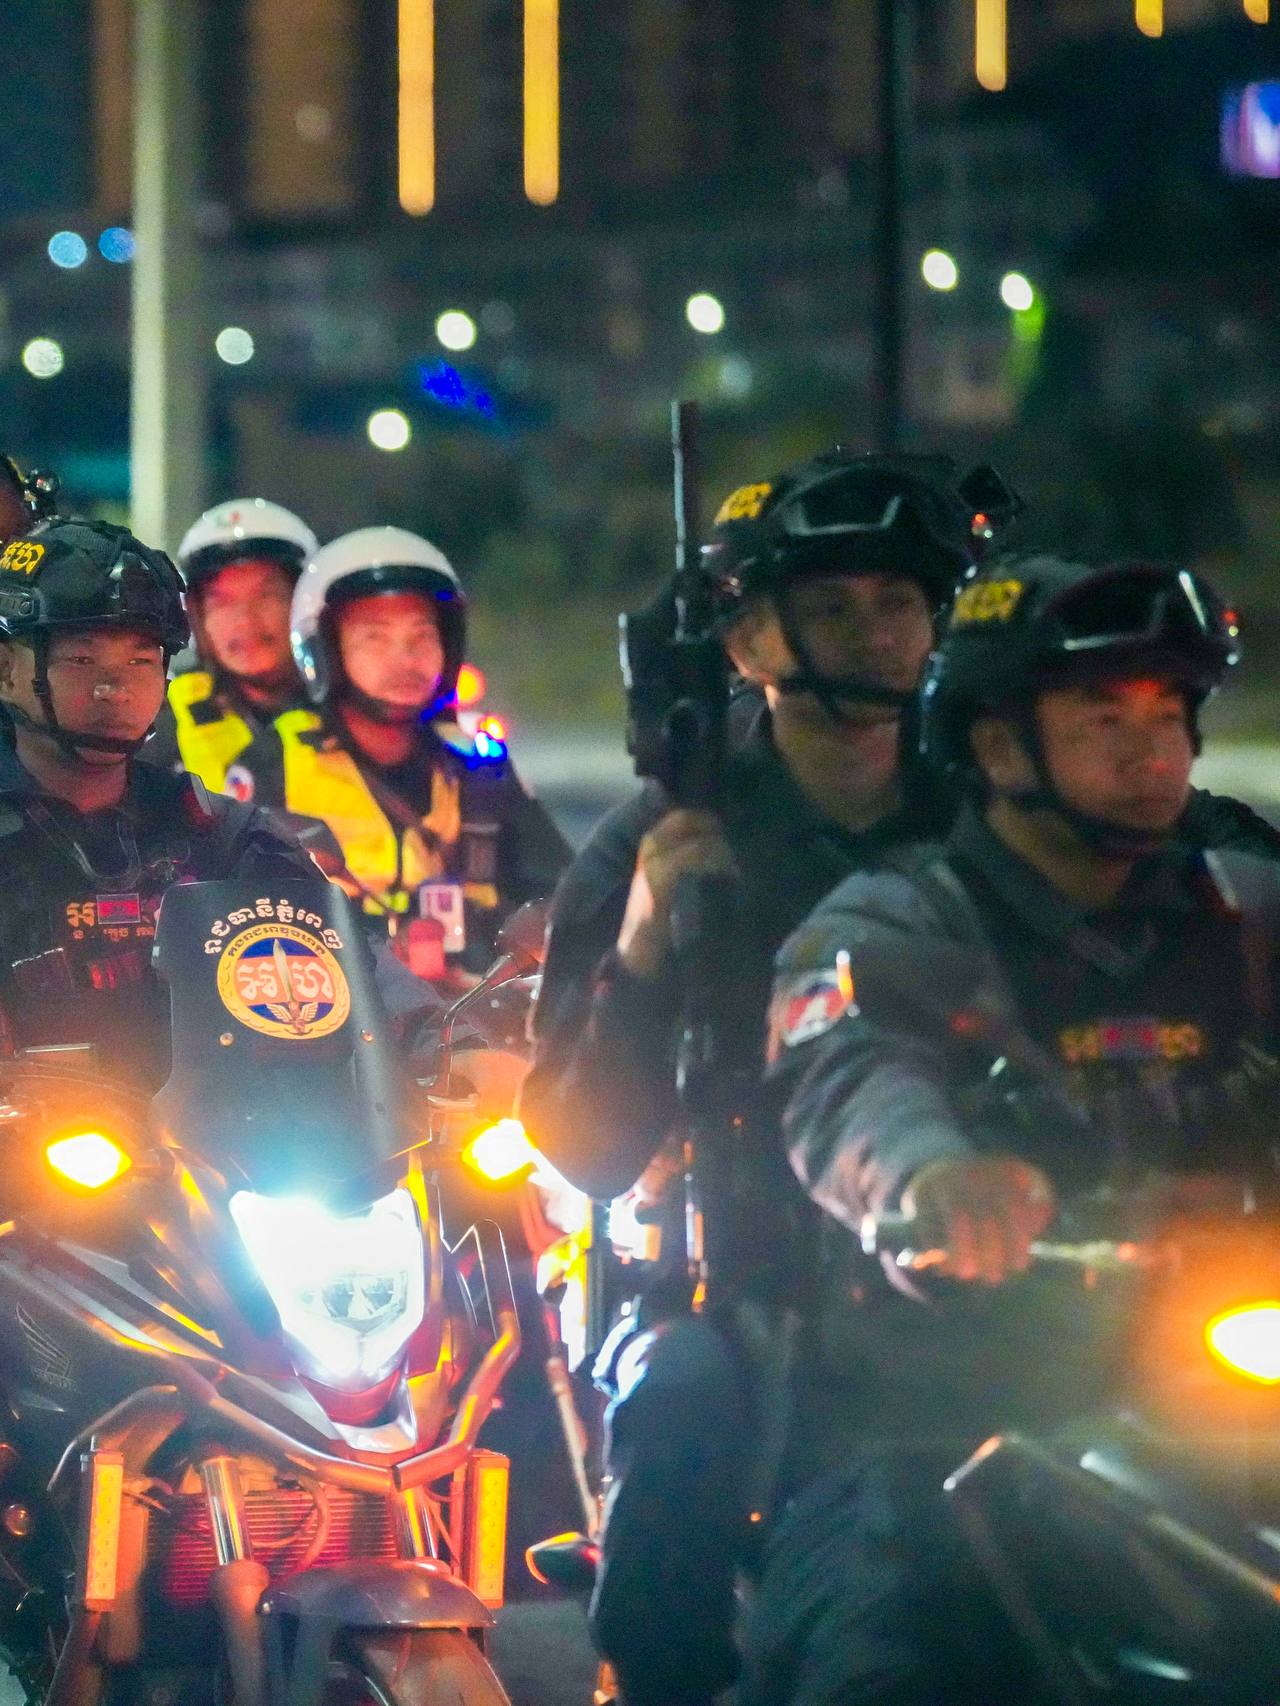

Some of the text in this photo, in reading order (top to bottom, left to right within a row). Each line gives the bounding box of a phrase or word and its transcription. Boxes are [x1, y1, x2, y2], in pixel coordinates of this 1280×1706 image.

[204, 898, 344, 955] រាជធានីភ្នំពេញ
